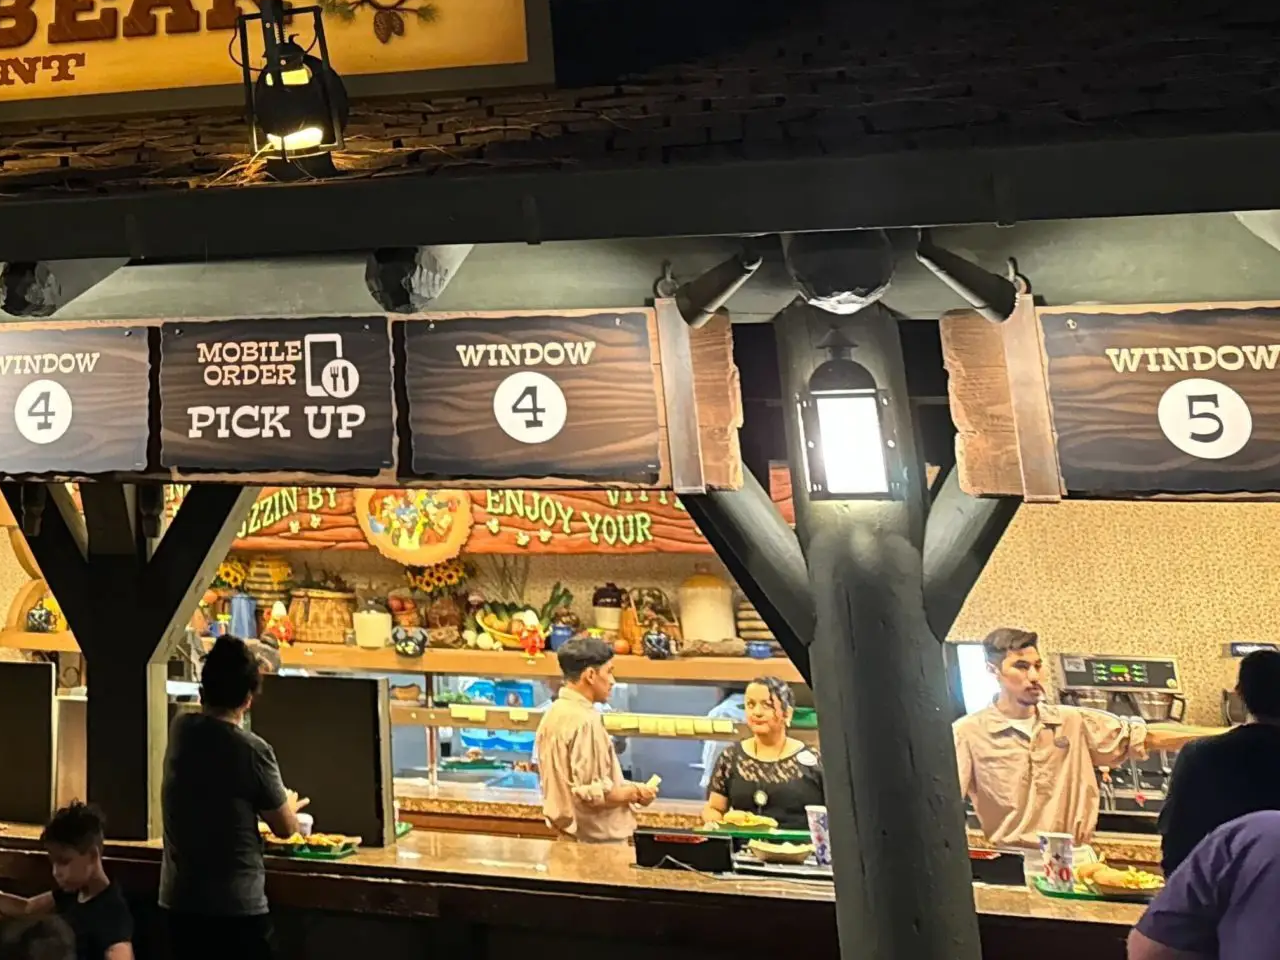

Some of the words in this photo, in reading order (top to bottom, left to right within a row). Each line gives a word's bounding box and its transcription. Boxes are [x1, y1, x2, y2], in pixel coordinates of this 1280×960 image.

[196, 340, 302, 363] MOBILE
[456, 341, 596, 367] WINDOW
[1106, 345, 1280, 373] WINDOW
[203, 363, 296, 386] ORDER
[27, 391, 56, 431] 4
[187, 405, 291, 438] PICK
[304, 404, 366, 439] UP
[511, 385, 546, 429] 4
[1185, 393, 1224, 443] 5
[486, 489, 575, 534] ENJOY
[582, 511, 653, 545] YOUR
